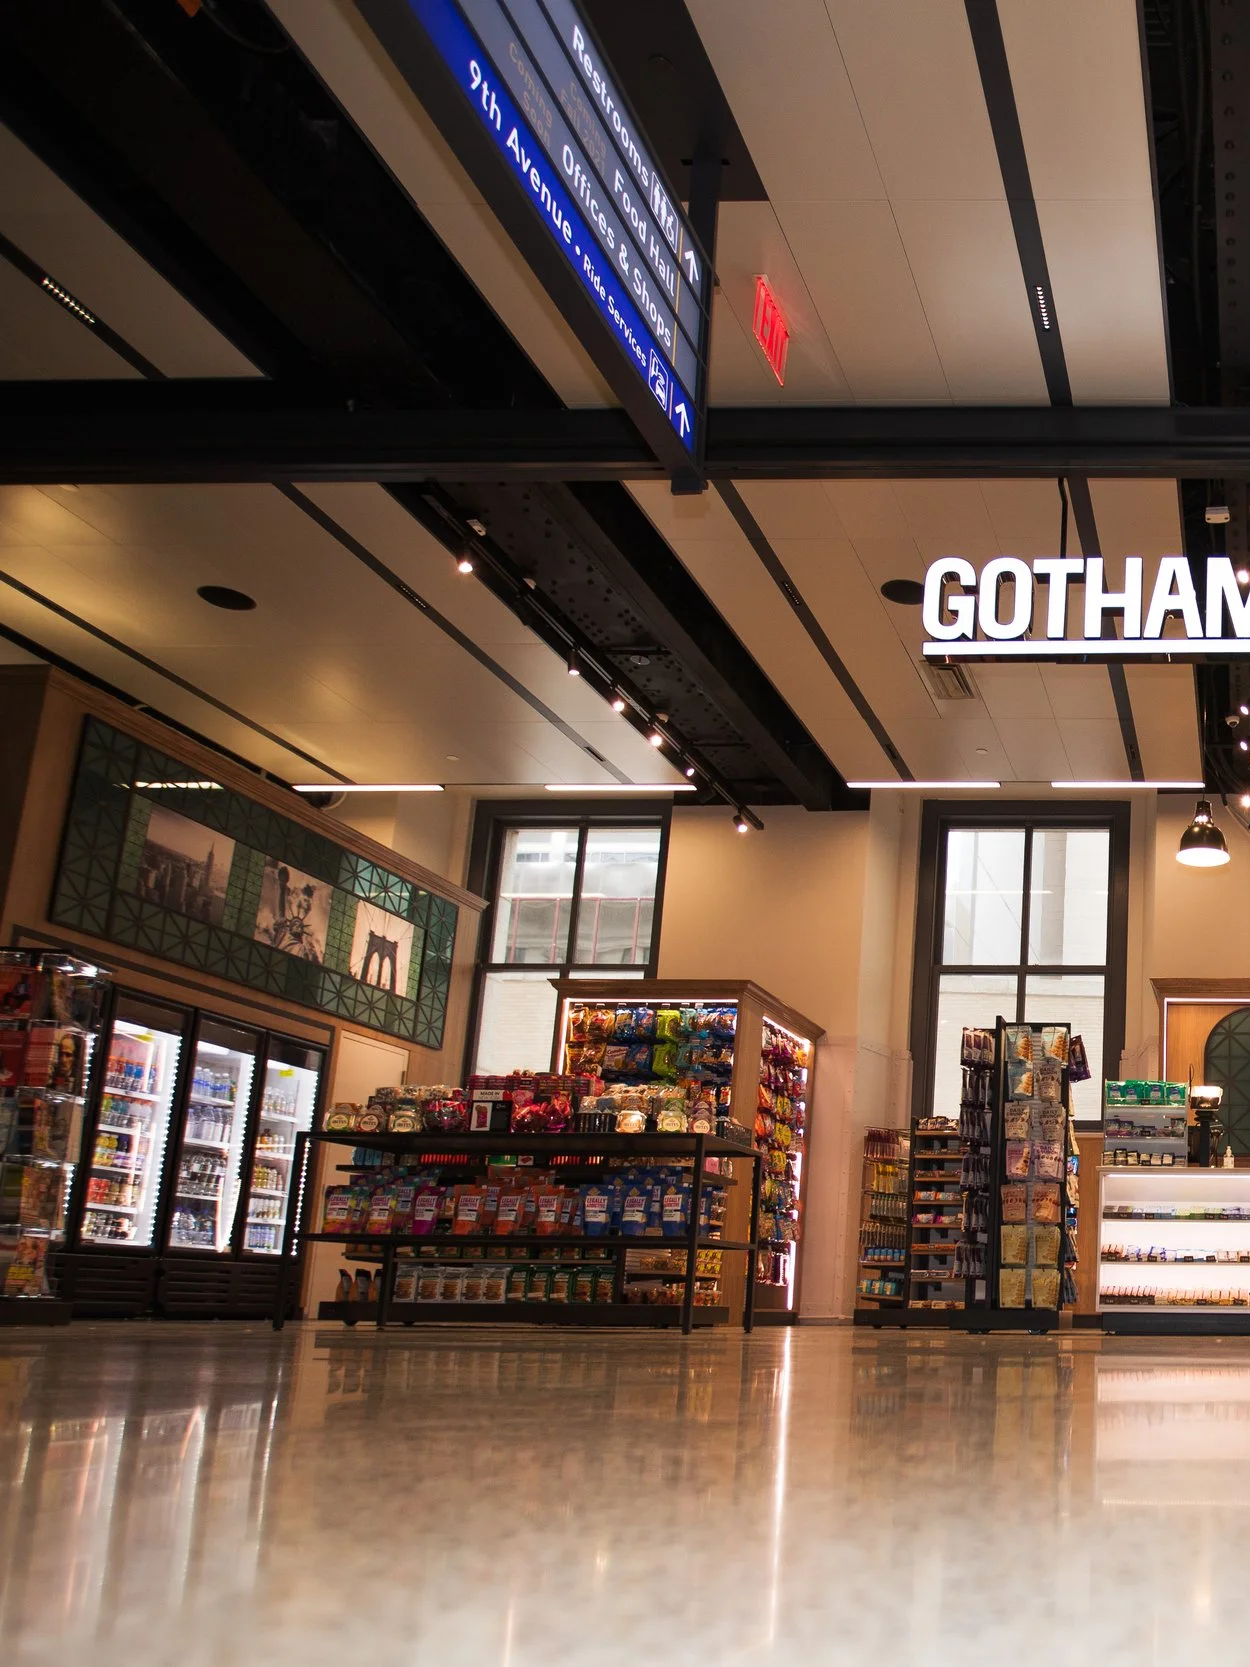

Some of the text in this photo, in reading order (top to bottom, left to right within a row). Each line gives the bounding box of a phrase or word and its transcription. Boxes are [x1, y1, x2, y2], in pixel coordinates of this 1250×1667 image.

[509, 42, 552, 128] Coming
[523, 91, 550, 148] Soon
[572, 24, 649, 187] Restrooms
[469, 60, 647, 367] 9th Avenue Ride Services
[562, 144, 671, 347] Offices & Shops
[614, 169, 675, 297] Food Hall
